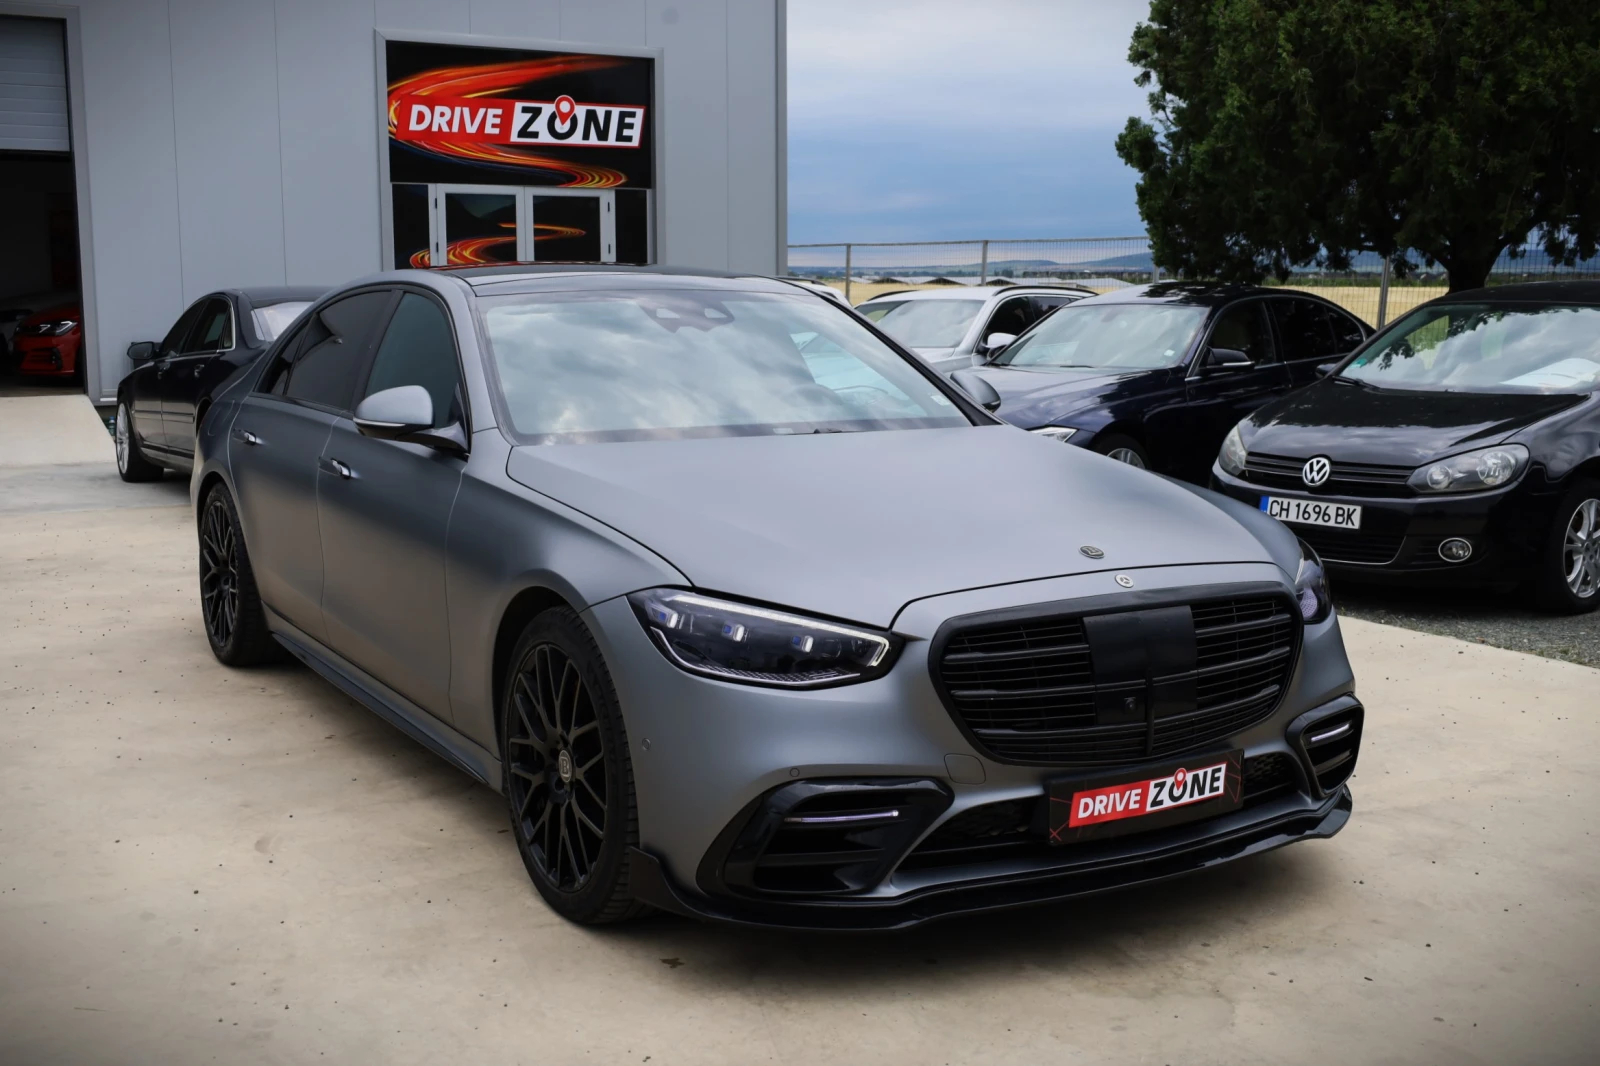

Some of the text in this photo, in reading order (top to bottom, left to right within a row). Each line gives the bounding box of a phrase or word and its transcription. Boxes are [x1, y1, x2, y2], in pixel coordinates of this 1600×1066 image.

[408, 104, 637, 143] DRIVE ZONE
[1295, 502, 1332, 524] 1696
[1334, 506, 1357, 527] BK
[1077, 767, 1223, 819] DRIVE ZONE
